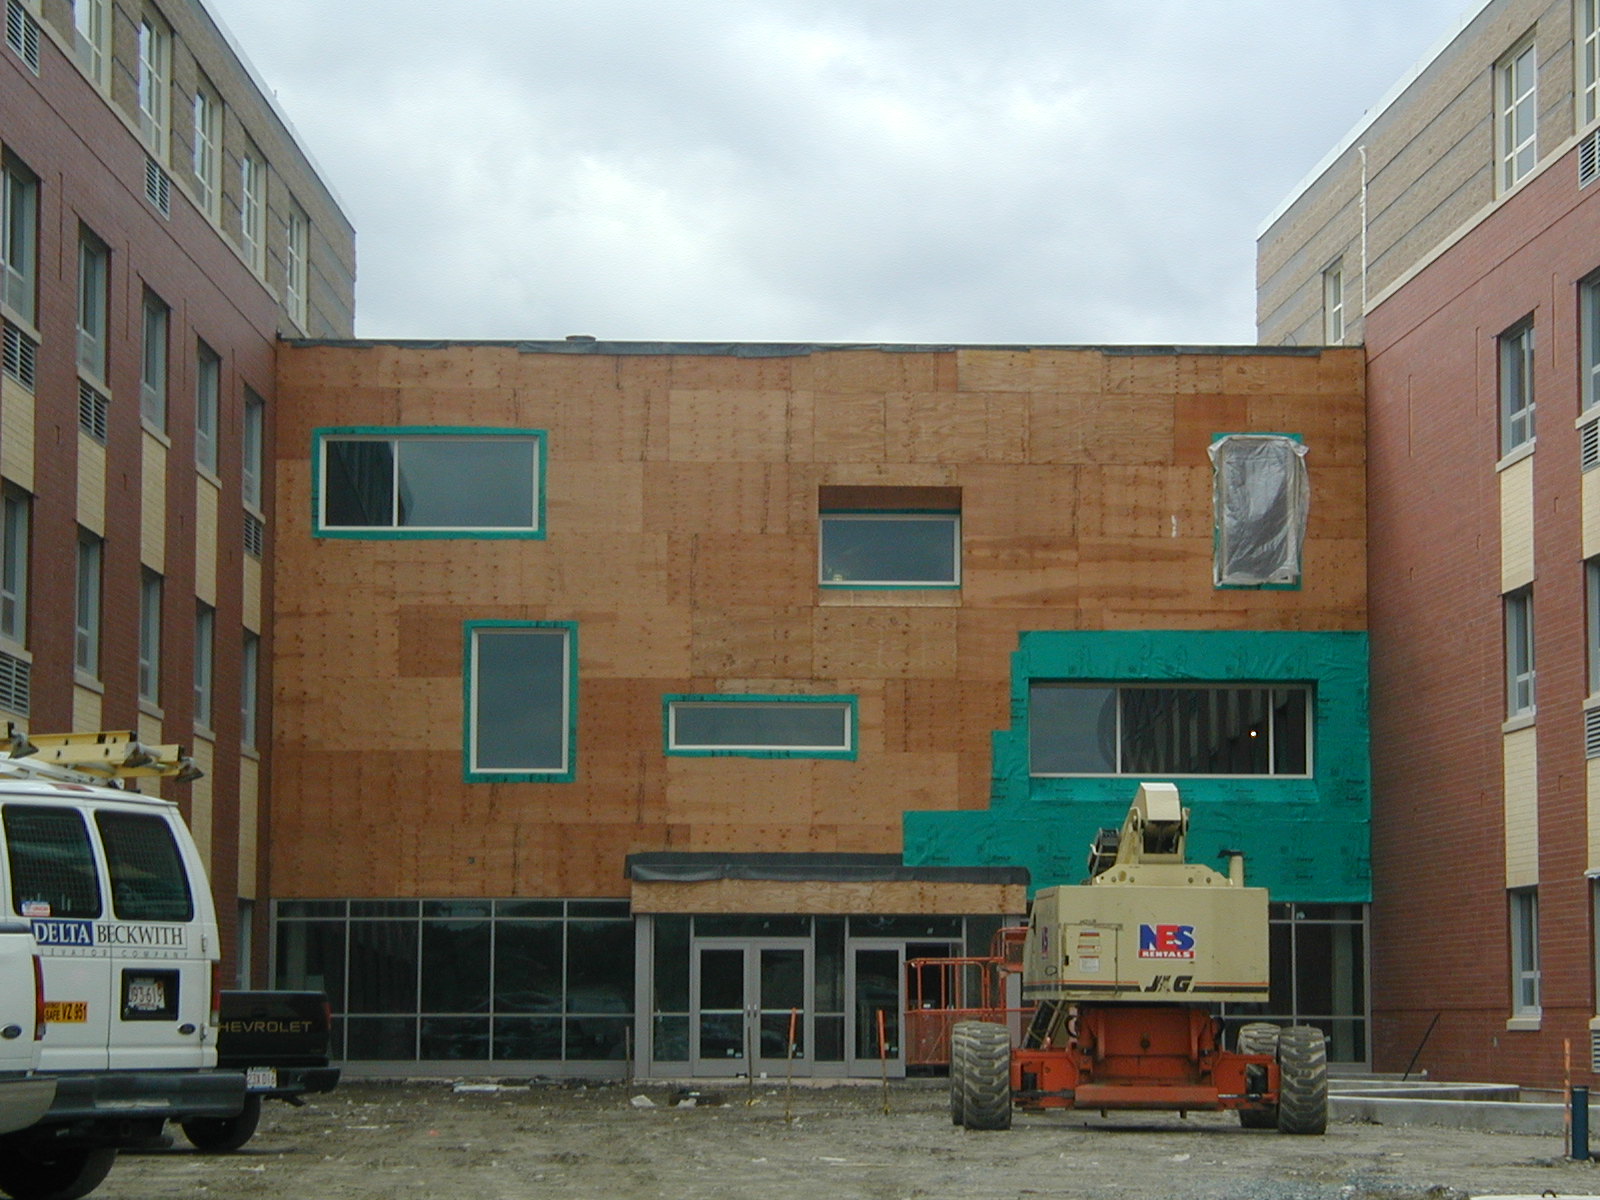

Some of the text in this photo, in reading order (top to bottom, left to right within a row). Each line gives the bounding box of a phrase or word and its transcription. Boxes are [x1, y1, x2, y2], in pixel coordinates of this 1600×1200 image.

[33, 923, 183, 945] DELTA BECKWITH
[1140, 924, 1195, 951] NES
[41, 947, 188, 959] LEVATOR COMPANY
[218, 1021, 313, 1033] HEVROLET
